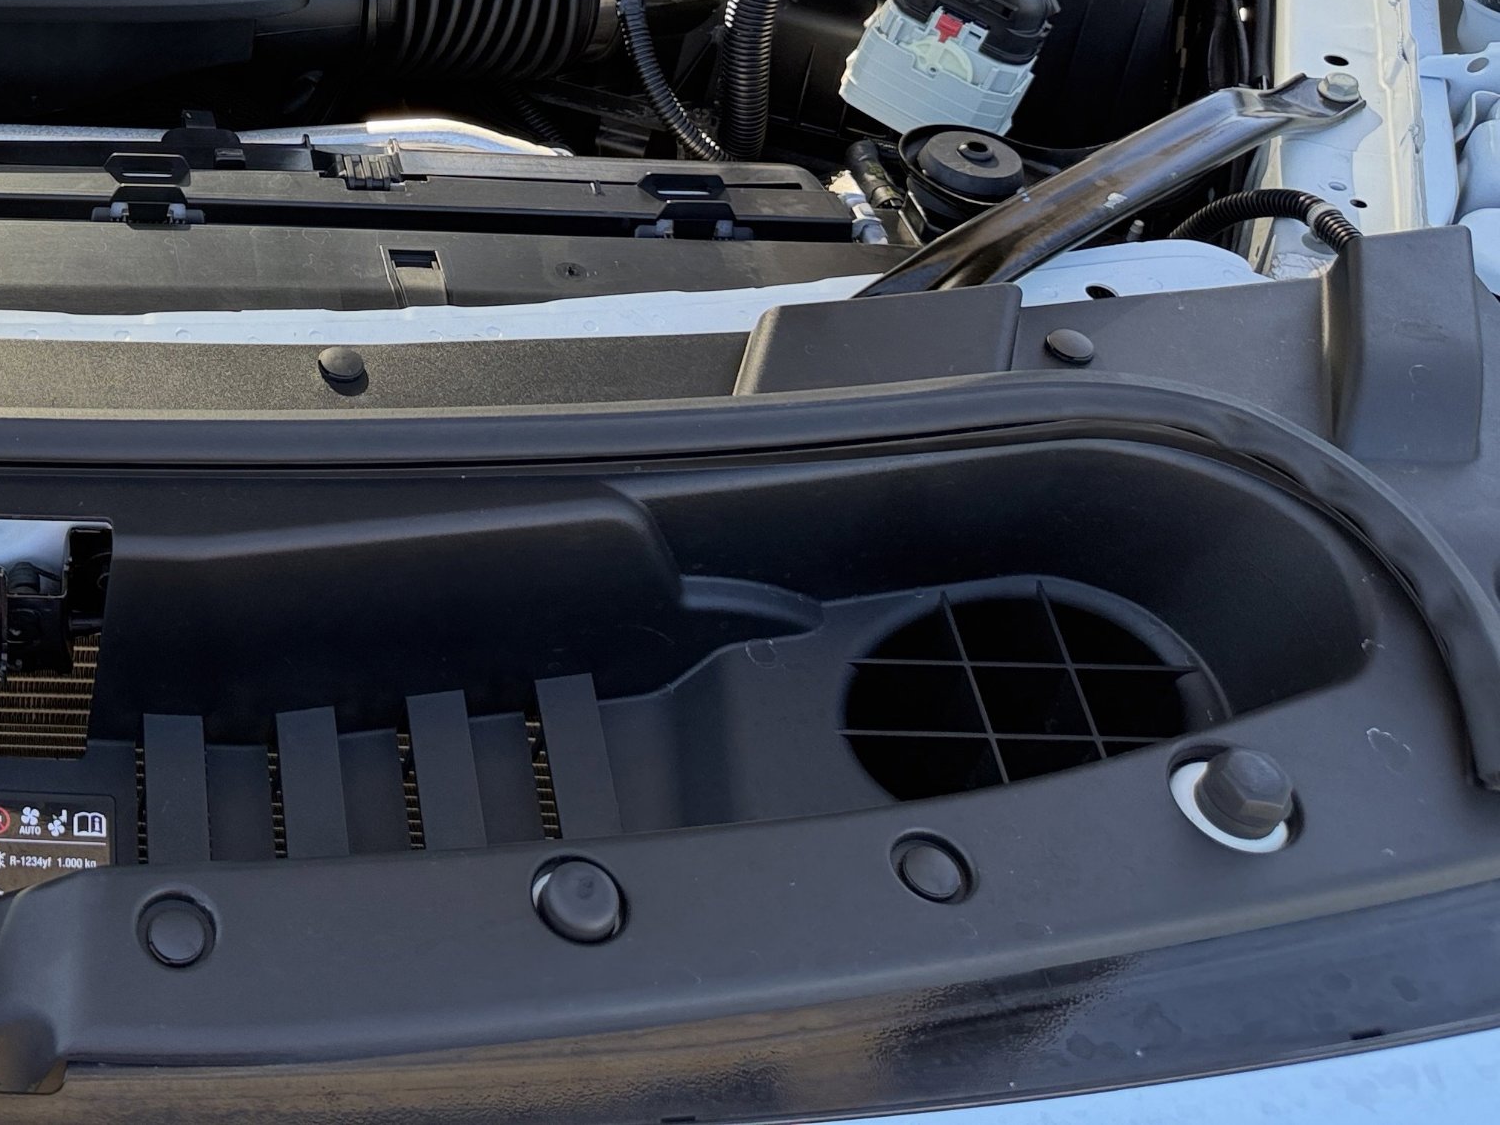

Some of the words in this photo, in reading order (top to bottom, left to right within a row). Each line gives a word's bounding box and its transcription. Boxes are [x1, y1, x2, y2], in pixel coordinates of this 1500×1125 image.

[19, 825, 41, 836] AUTO
[9, 855, 52, 870] R-1234yf
[57, 857, 83, 868] 1.000
